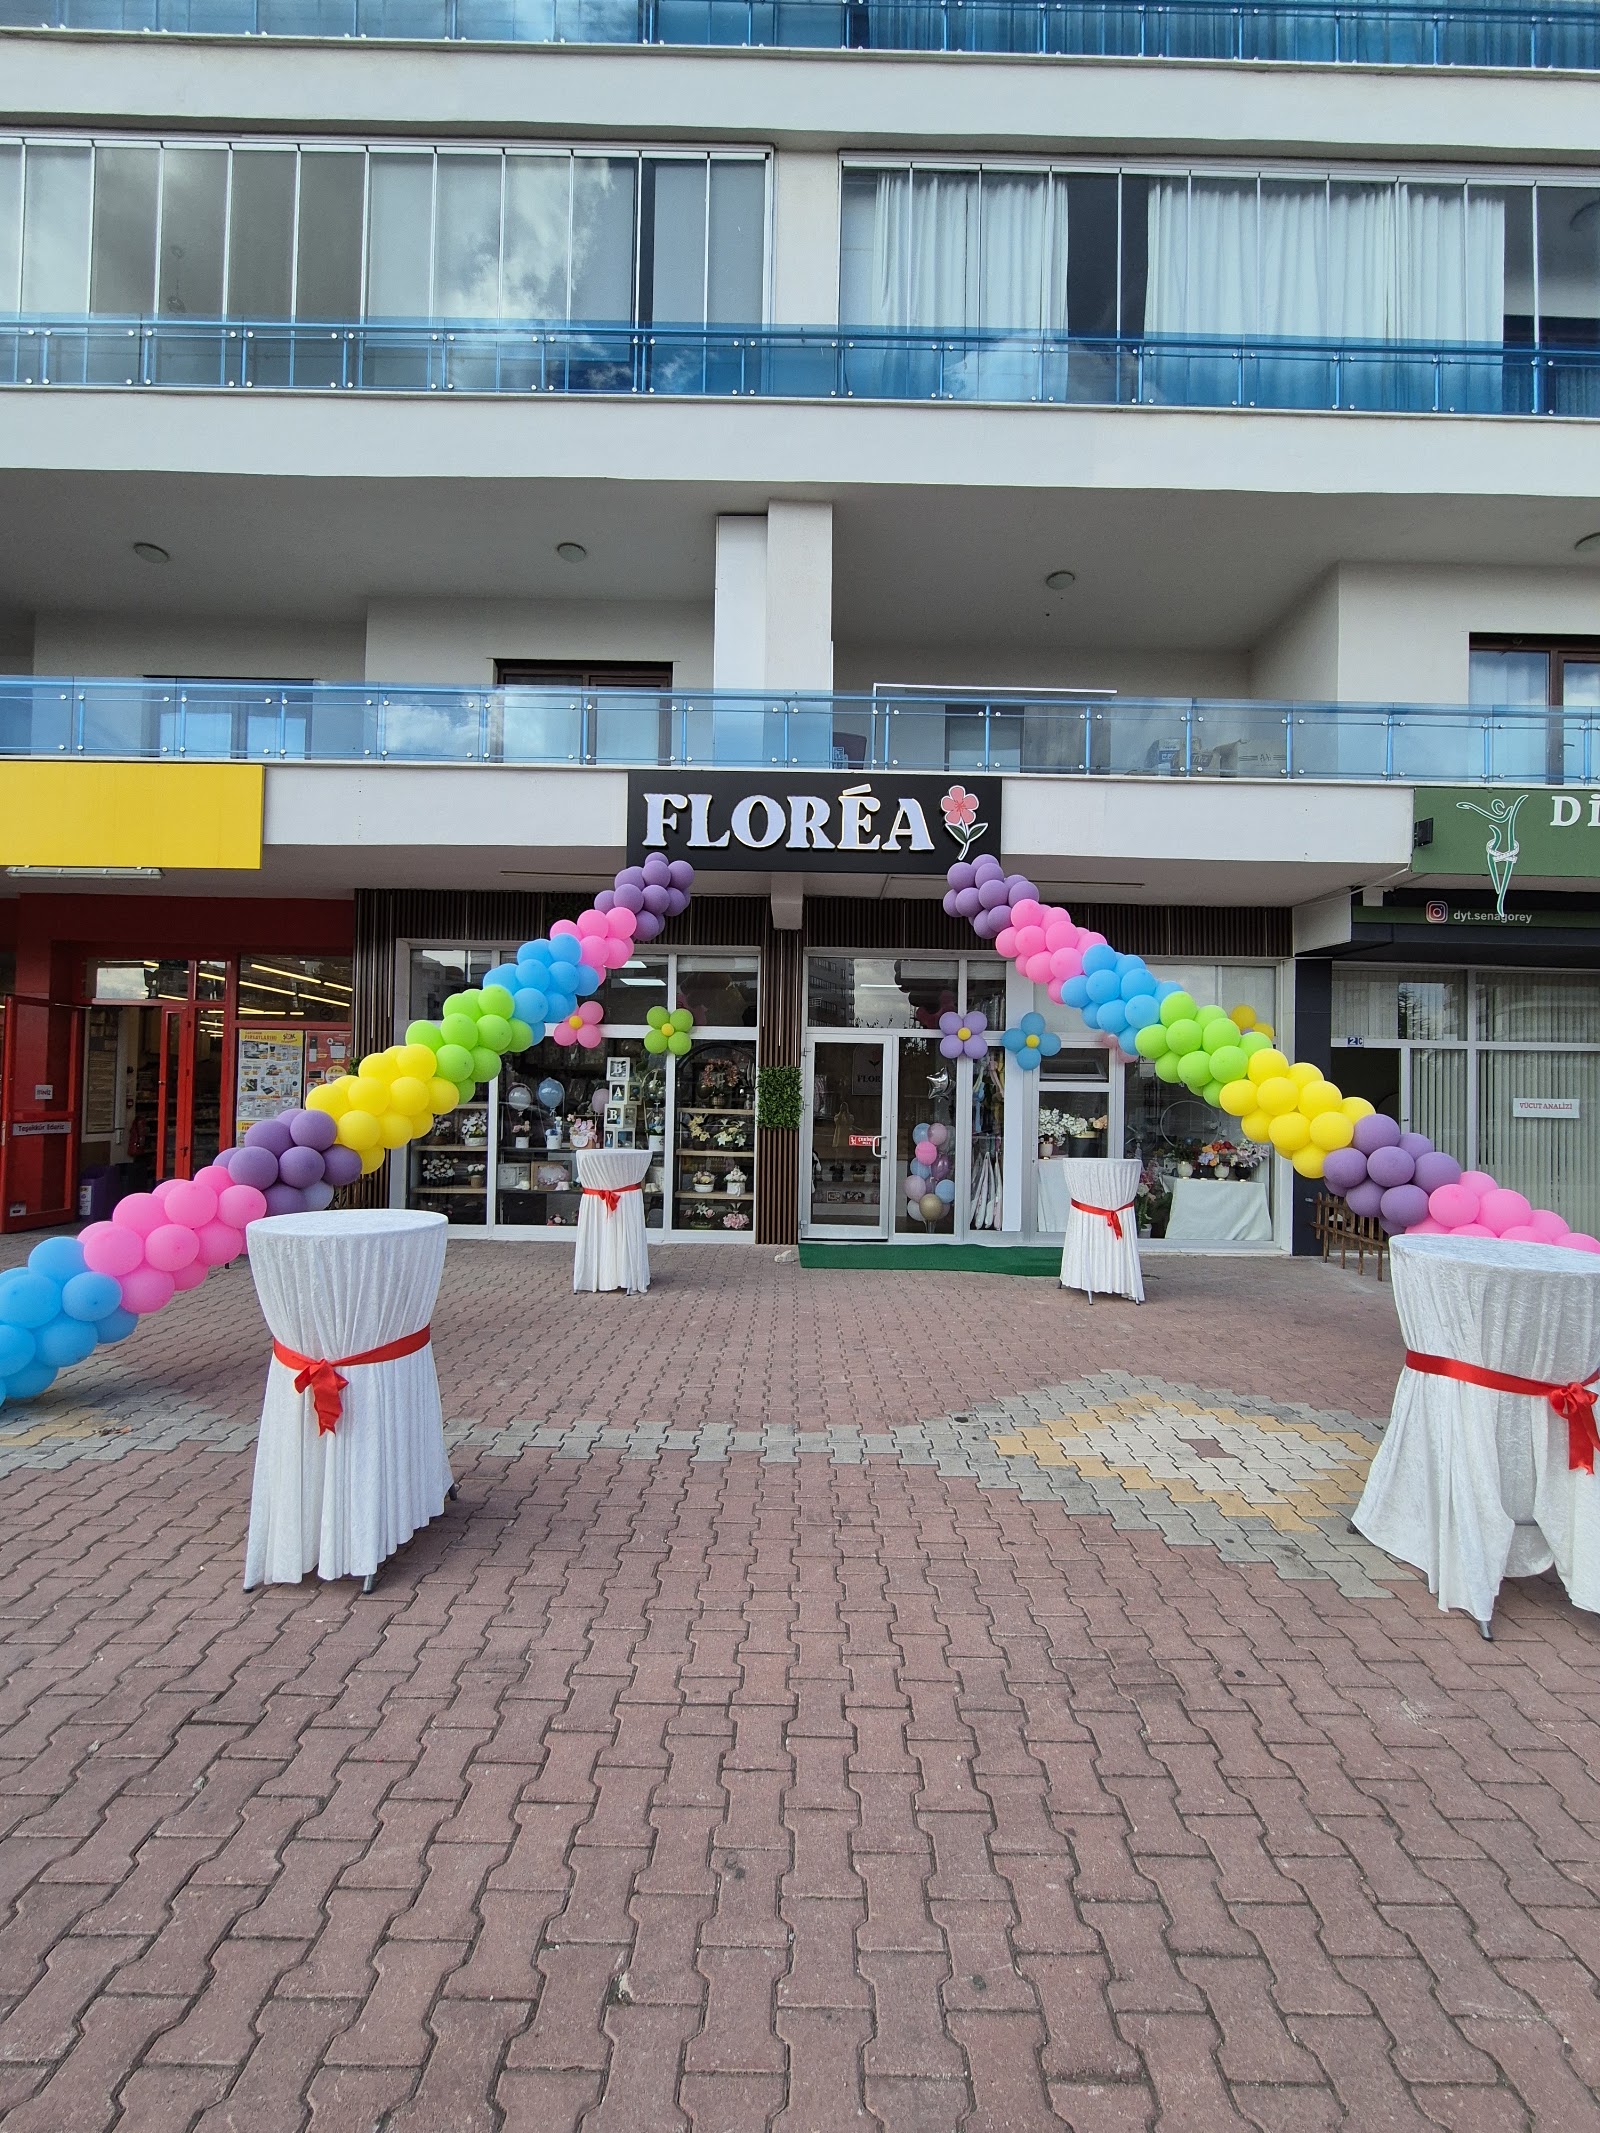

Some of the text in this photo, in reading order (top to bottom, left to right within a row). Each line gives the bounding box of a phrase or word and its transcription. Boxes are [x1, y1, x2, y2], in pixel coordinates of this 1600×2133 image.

[642, 783, 935, 850] FLORÉA
[1453, 910, 1532, 923] dyt.senagorey
[1543, 1102, 1573, 1110] ANALİZİ
